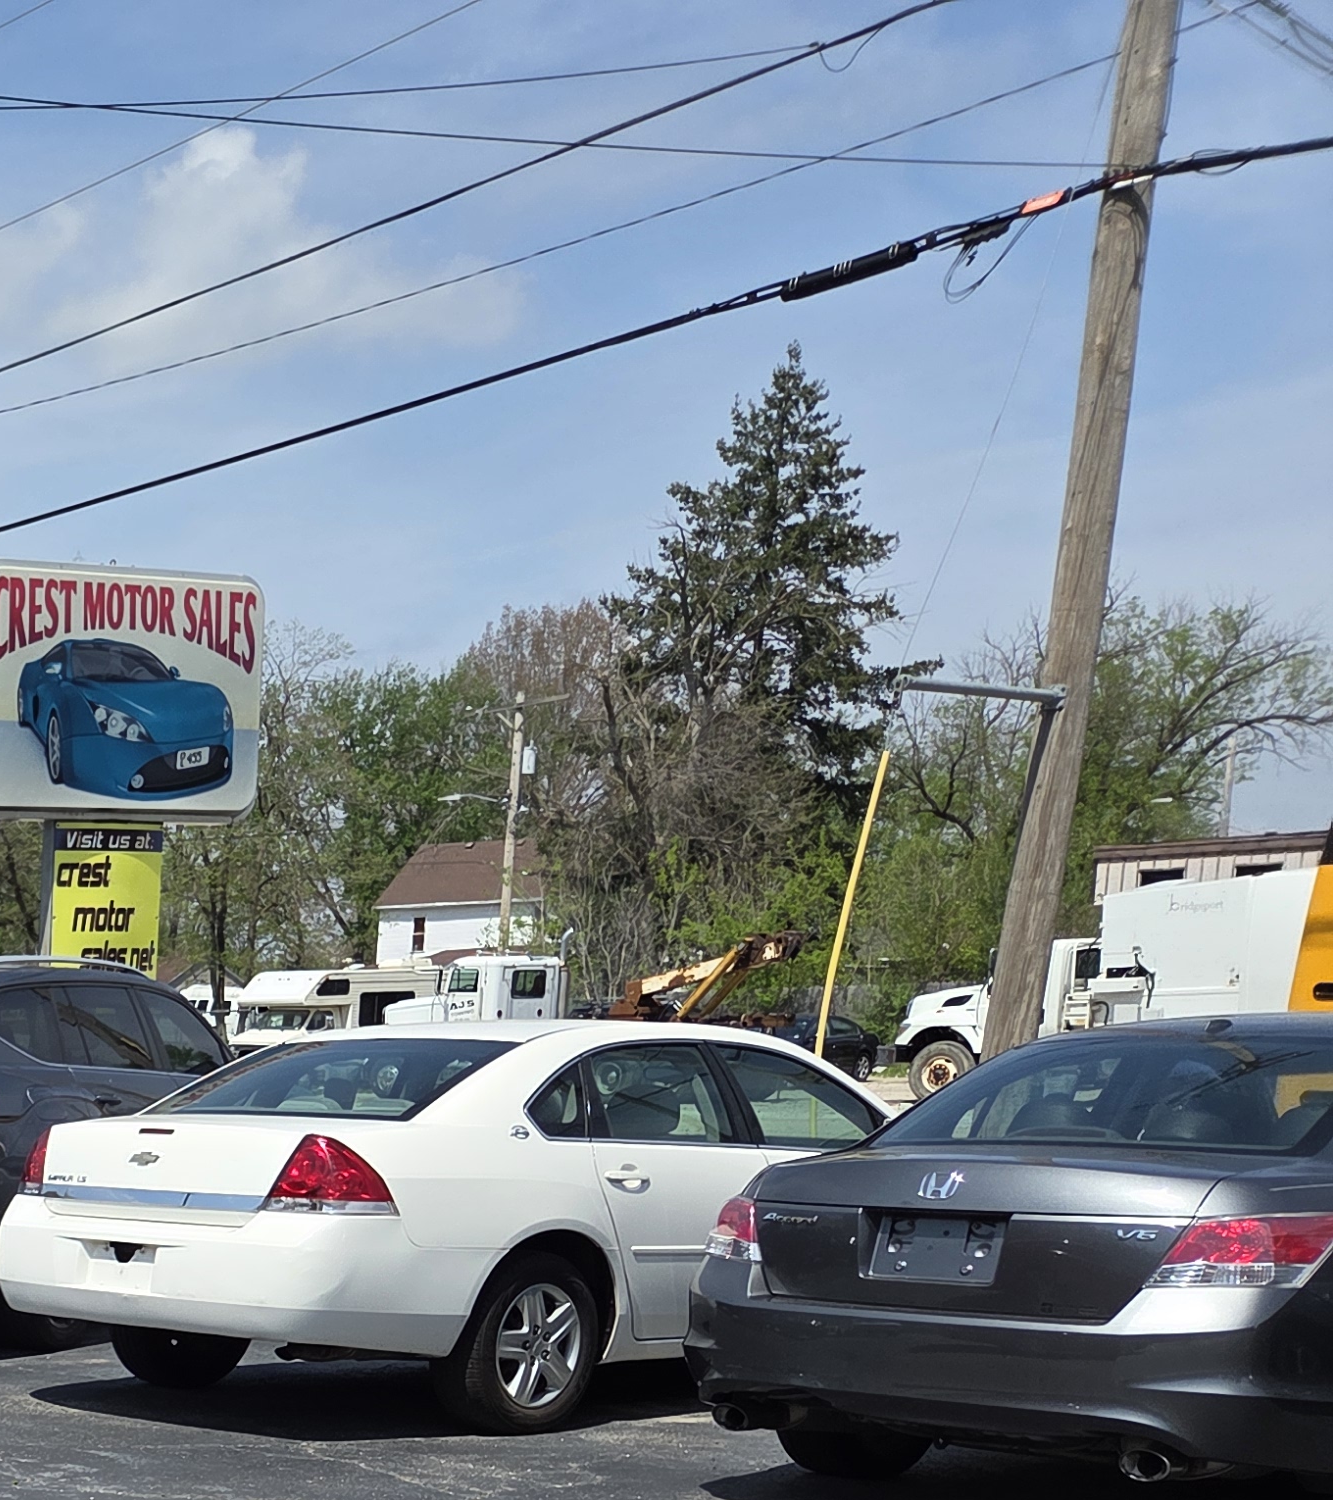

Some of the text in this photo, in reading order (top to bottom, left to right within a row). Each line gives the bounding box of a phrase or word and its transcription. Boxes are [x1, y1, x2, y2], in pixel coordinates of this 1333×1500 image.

[83, 581, 176, 637] MOTOR
[182, 587, 257, 675] SALES
[66, 831, 104, 848] Visit
[108, 834, 131, 849] us
[56, 855, 111, 888] crest
[72, 900, 135, 932] motor
